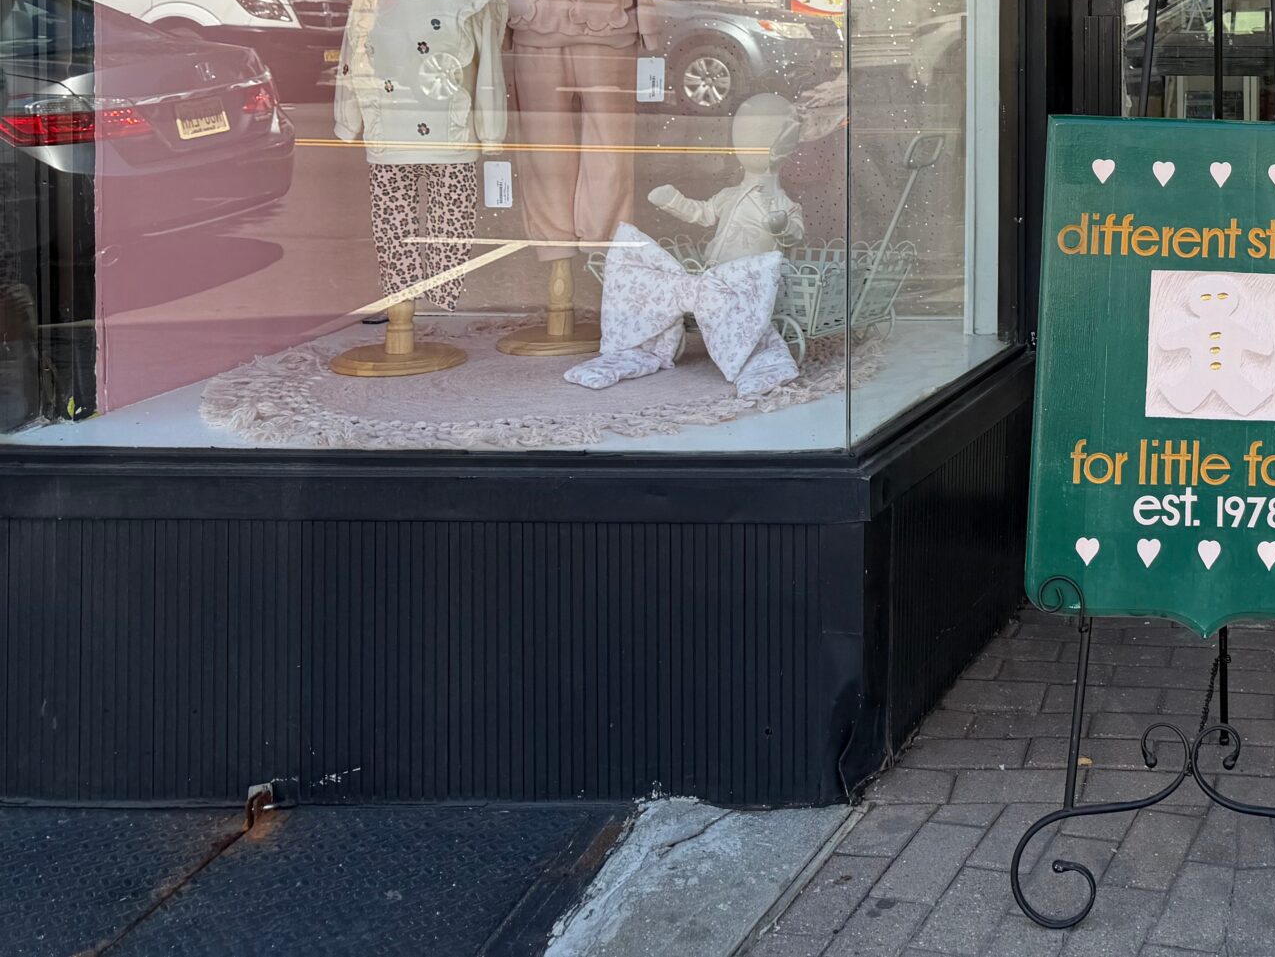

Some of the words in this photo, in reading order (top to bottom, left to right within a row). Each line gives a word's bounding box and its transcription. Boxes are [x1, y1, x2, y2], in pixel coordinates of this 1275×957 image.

[1057, 212, 1242, 260] different
[1070, 439, 1129, 486] for
[1137, 439, 1231, 487] little
[1132, 487, 1202, 528] est.
